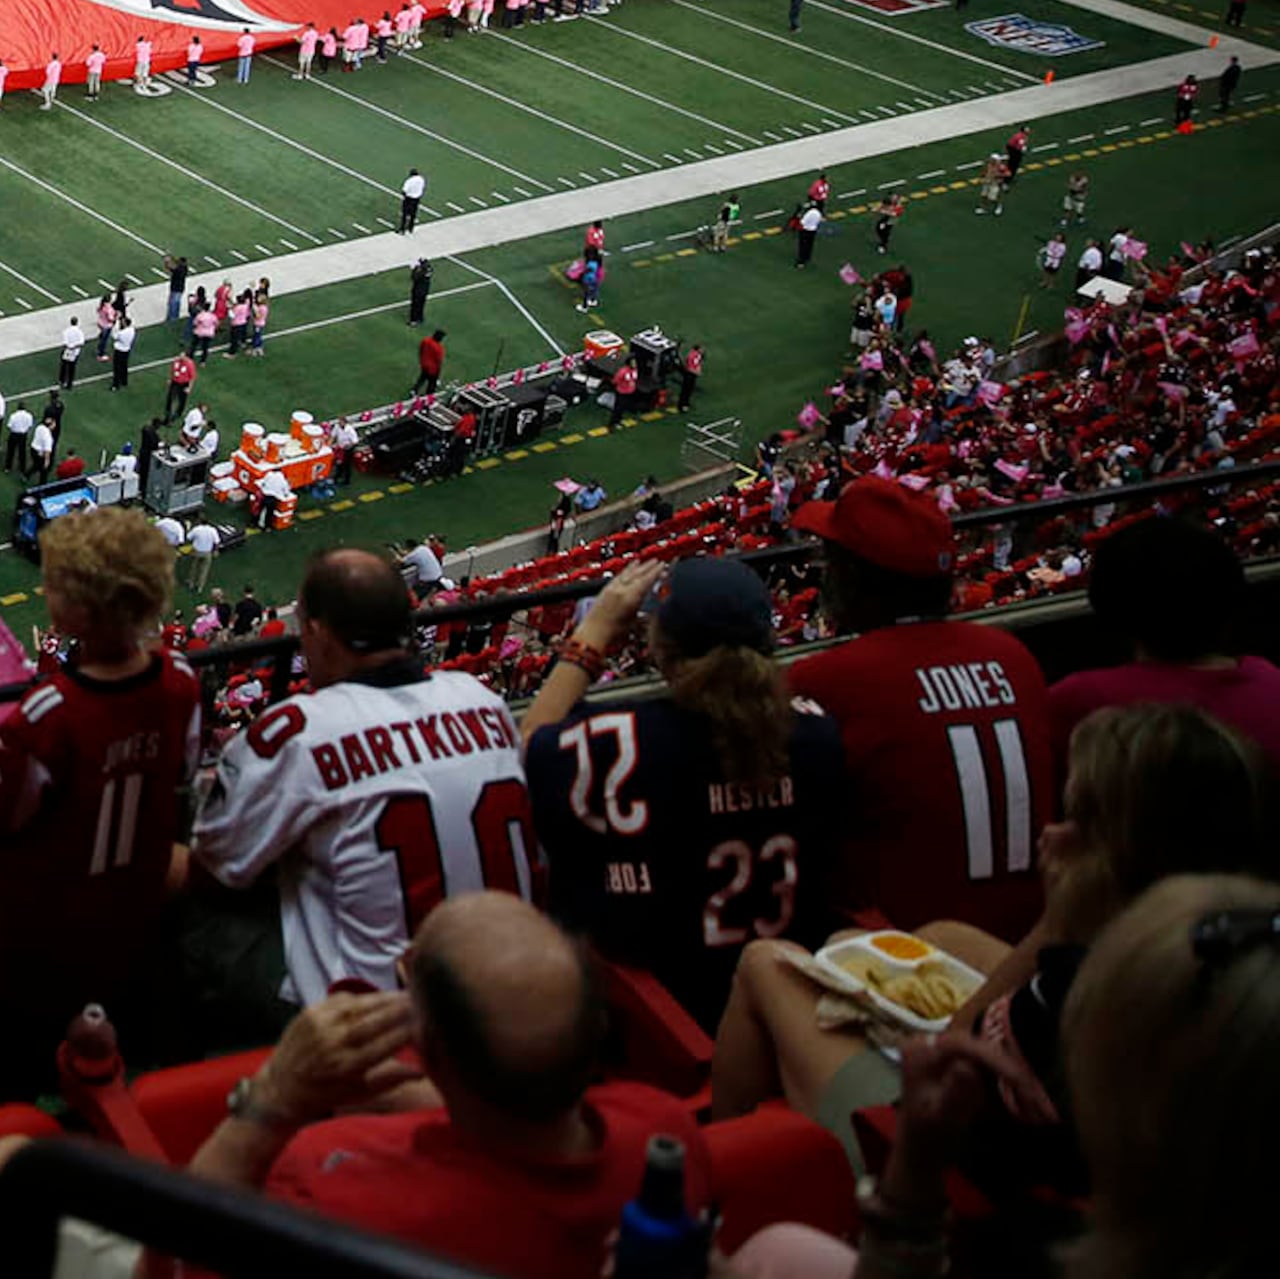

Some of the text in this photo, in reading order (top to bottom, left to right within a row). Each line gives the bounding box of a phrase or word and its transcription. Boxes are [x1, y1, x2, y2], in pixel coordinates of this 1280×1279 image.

[21, 683, 66, 725] 11
[915, 659, 1017, 717] JONES
[88, 772, 145, 877] 11
[706, 775, 796, 815] HESTER
[946, 718, 1033, 881] 11
[373, 778, 549, 936] 10
[701, 832, 801, 948] 23
